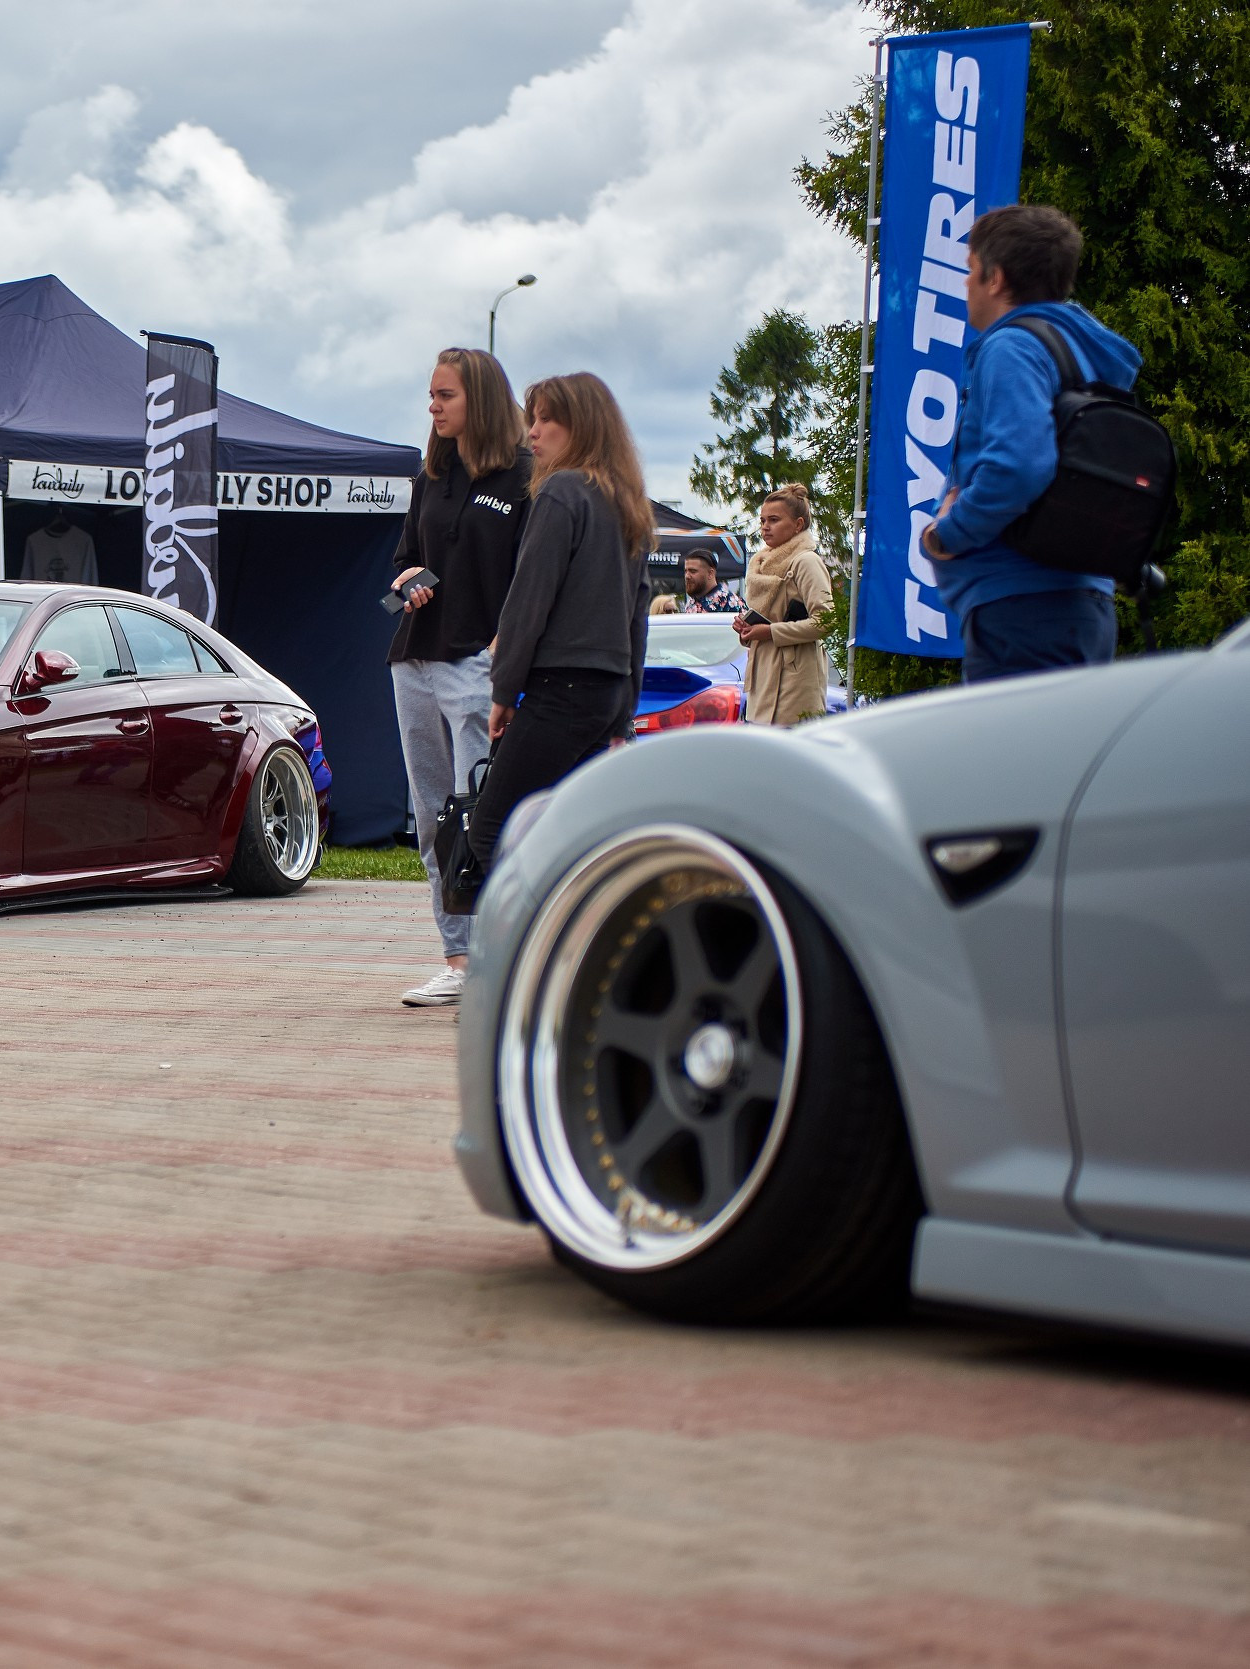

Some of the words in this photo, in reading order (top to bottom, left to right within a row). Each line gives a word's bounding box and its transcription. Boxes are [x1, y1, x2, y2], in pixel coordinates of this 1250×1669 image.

[912, 50, 980, 354] TIRES
[256, 476, 333, 508] SHOP
[474, 494, 512, 515] иные
